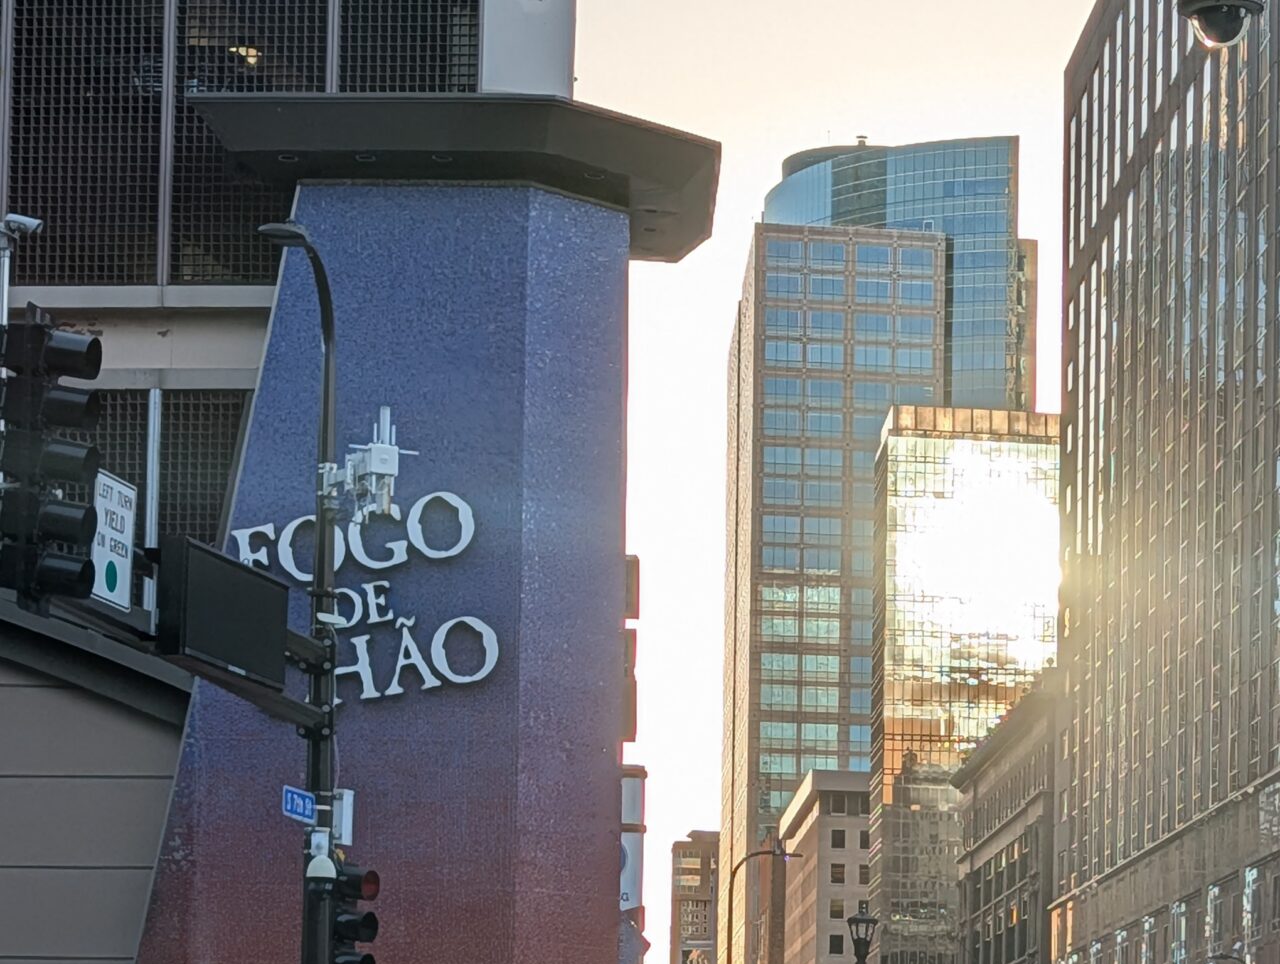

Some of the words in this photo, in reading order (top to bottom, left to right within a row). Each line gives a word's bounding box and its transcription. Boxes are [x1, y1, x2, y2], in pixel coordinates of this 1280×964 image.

[98, 481, 114, 502] LEFT
[117, 490, 132, 512] TURN
[96, 530, 106, 548] ON
[104, 507, 126, 534] YIELD
[231, 491, 475, 582] FOGO
[333, 580, 394, 629] DE
[304, 616, 499, 706] HÃO
